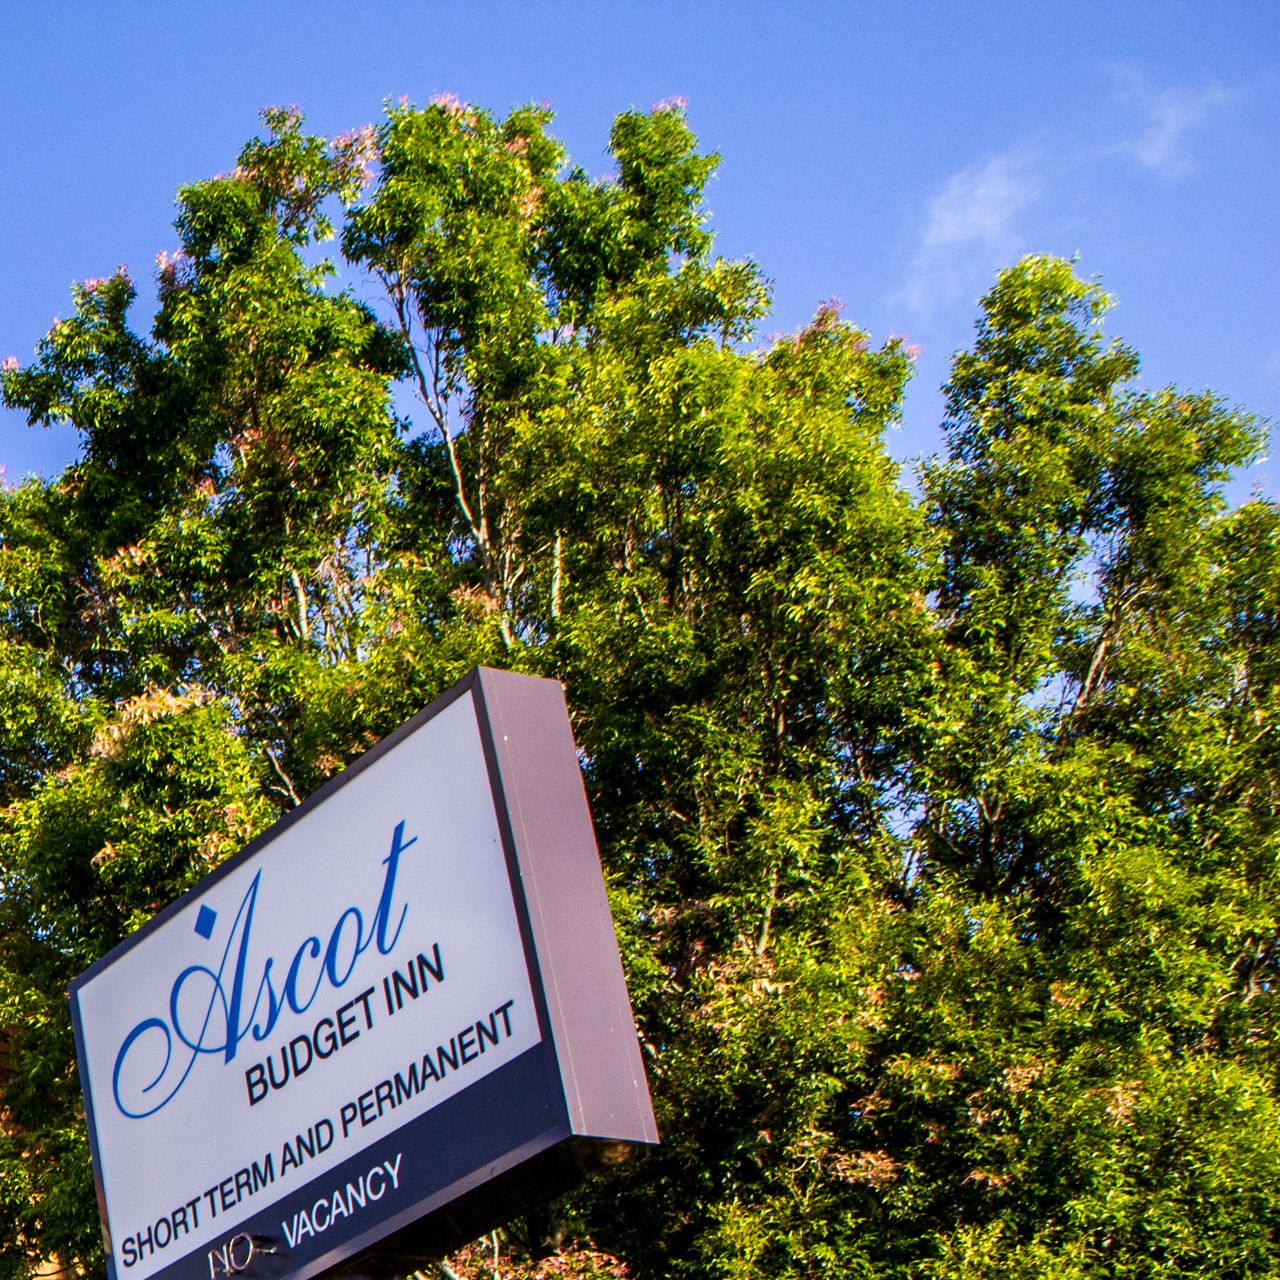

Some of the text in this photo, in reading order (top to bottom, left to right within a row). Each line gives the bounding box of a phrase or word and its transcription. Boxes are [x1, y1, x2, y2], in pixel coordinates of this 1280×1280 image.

[113, 819, 418, 1119] Ascot
[244, 942, 445, 1107] BUDGET INN
[121, 1000, 514, 1268] SHORT TERM AND PERMANENT
[281, 1153, 403, 1249] VACANCY
